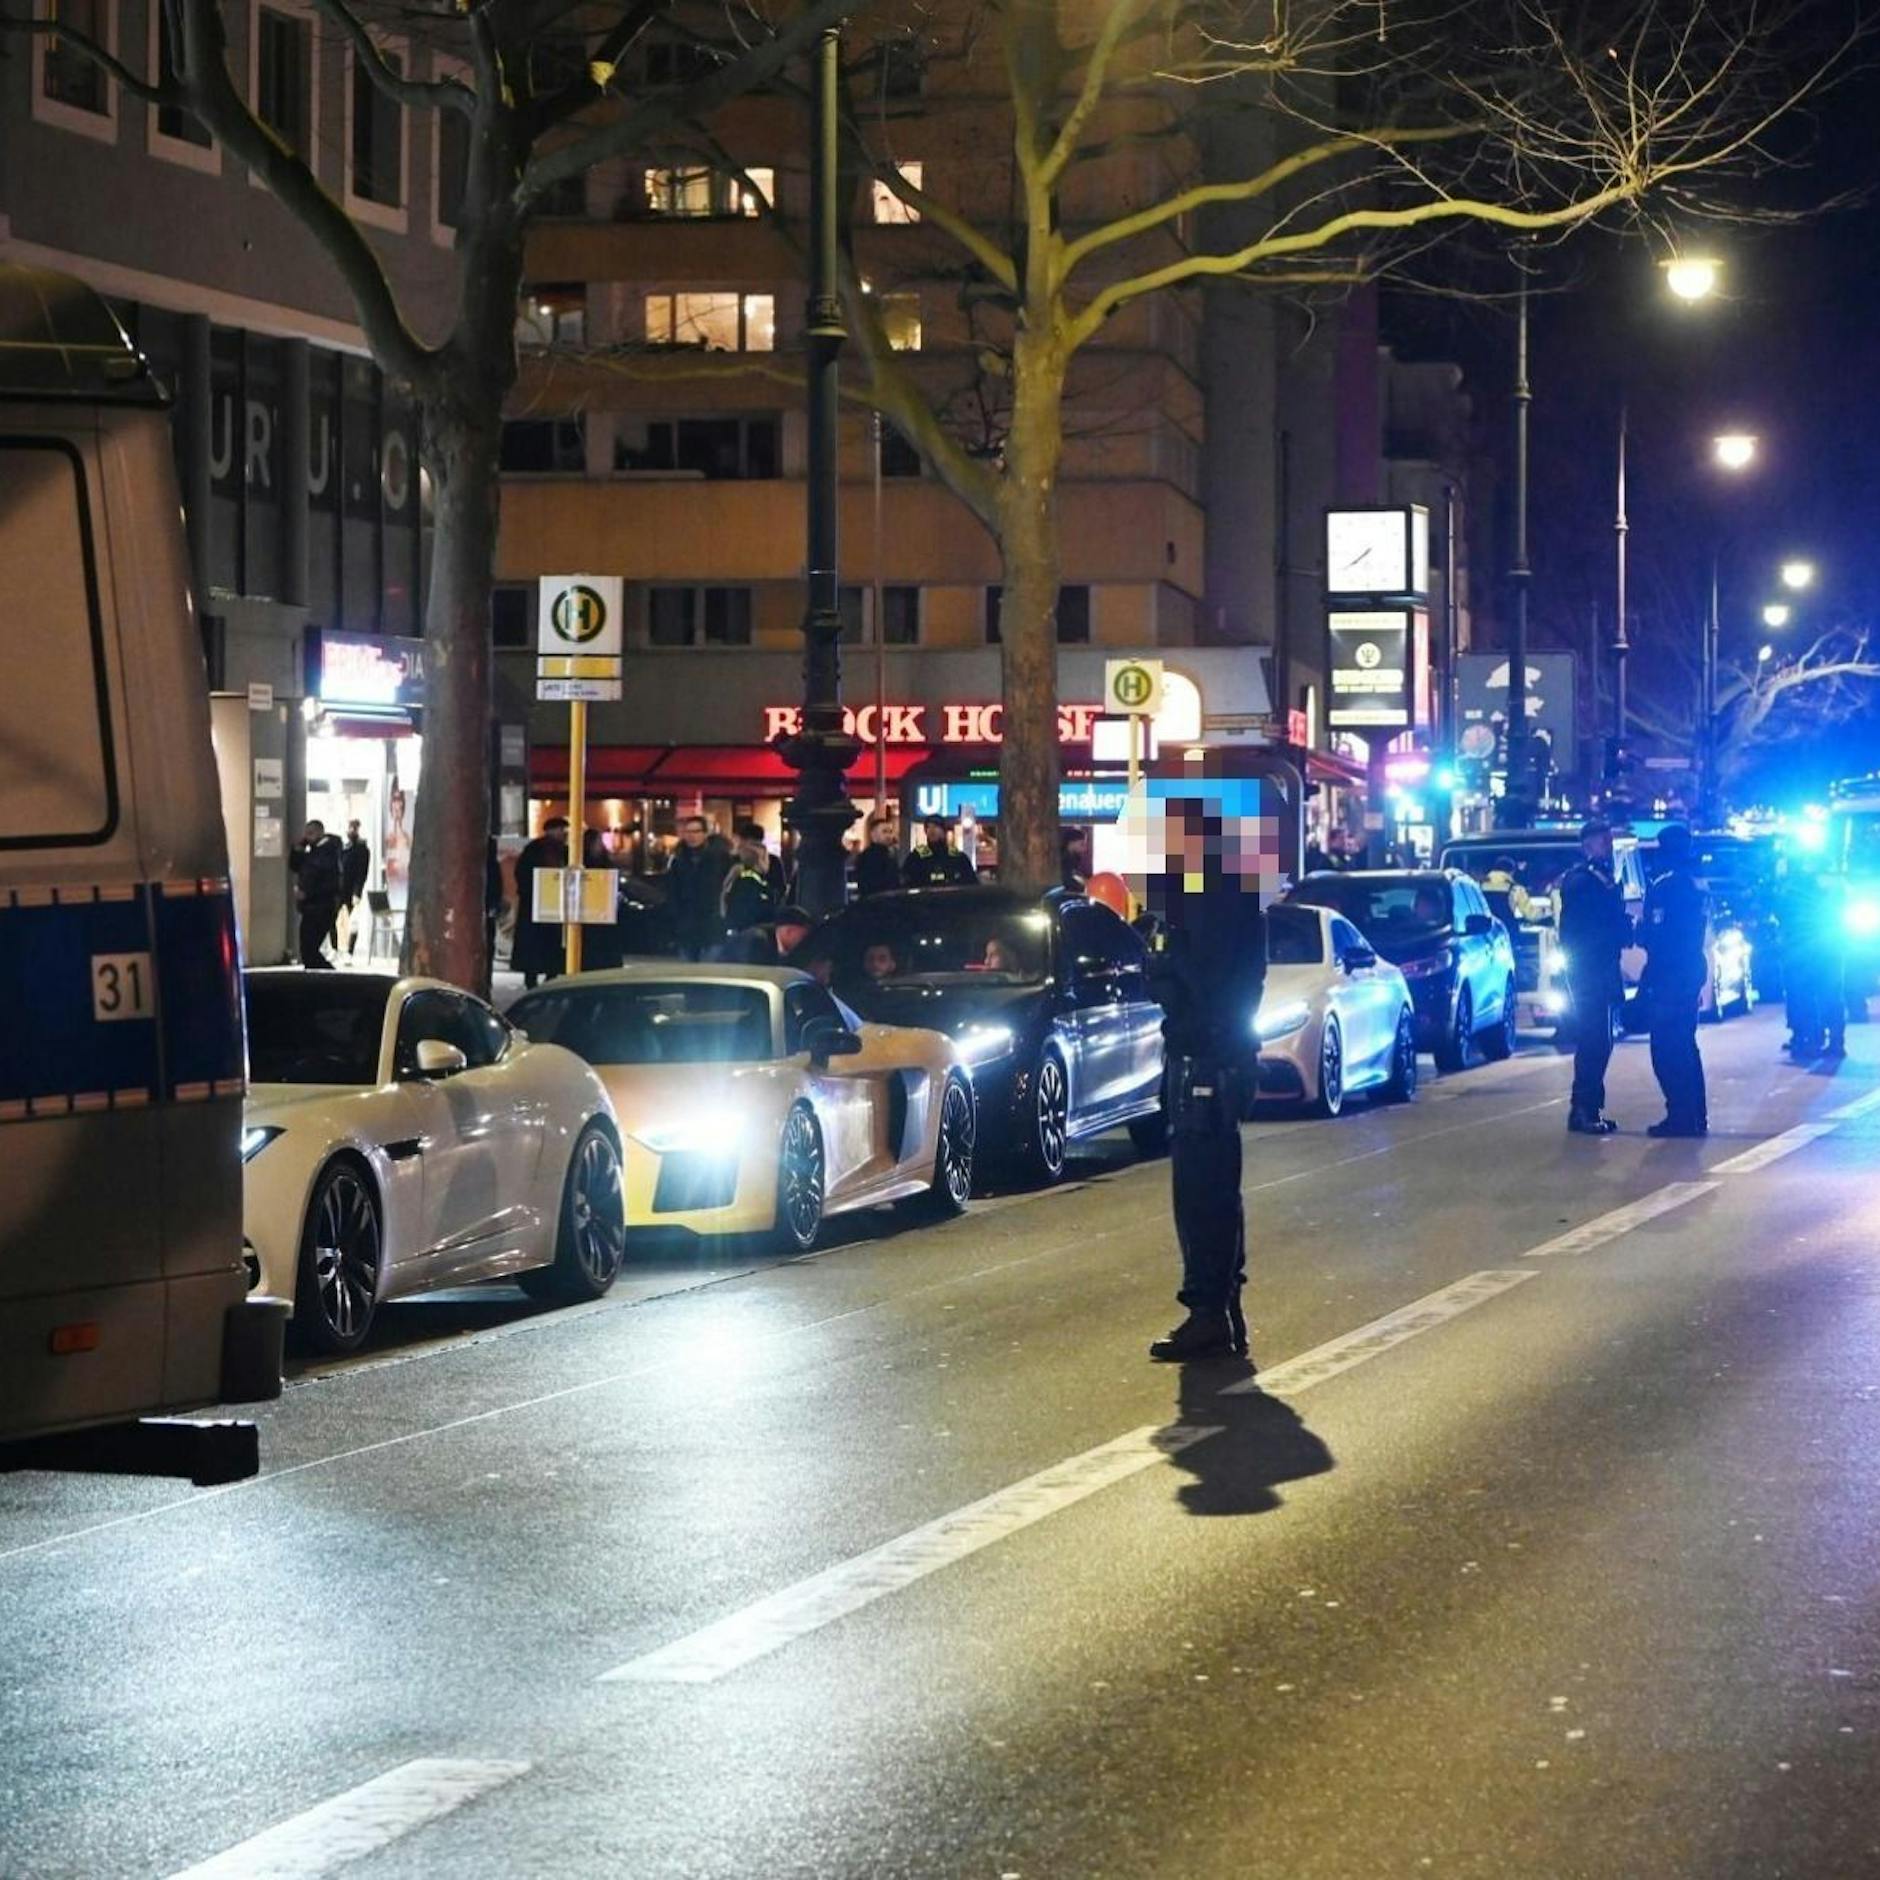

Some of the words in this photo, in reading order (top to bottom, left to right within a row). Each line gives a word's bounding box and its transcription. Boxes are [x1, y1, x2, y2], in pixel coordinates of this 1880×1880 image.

[564, 598, 592, 630] H
[1122, 675, 1142, 699] H
[764, 704, 926, 743] BCK
[943, 704, 1105, 743] HOSE
[918, 785, 941, 815] U
[98, 961, 141, 1012] 31
